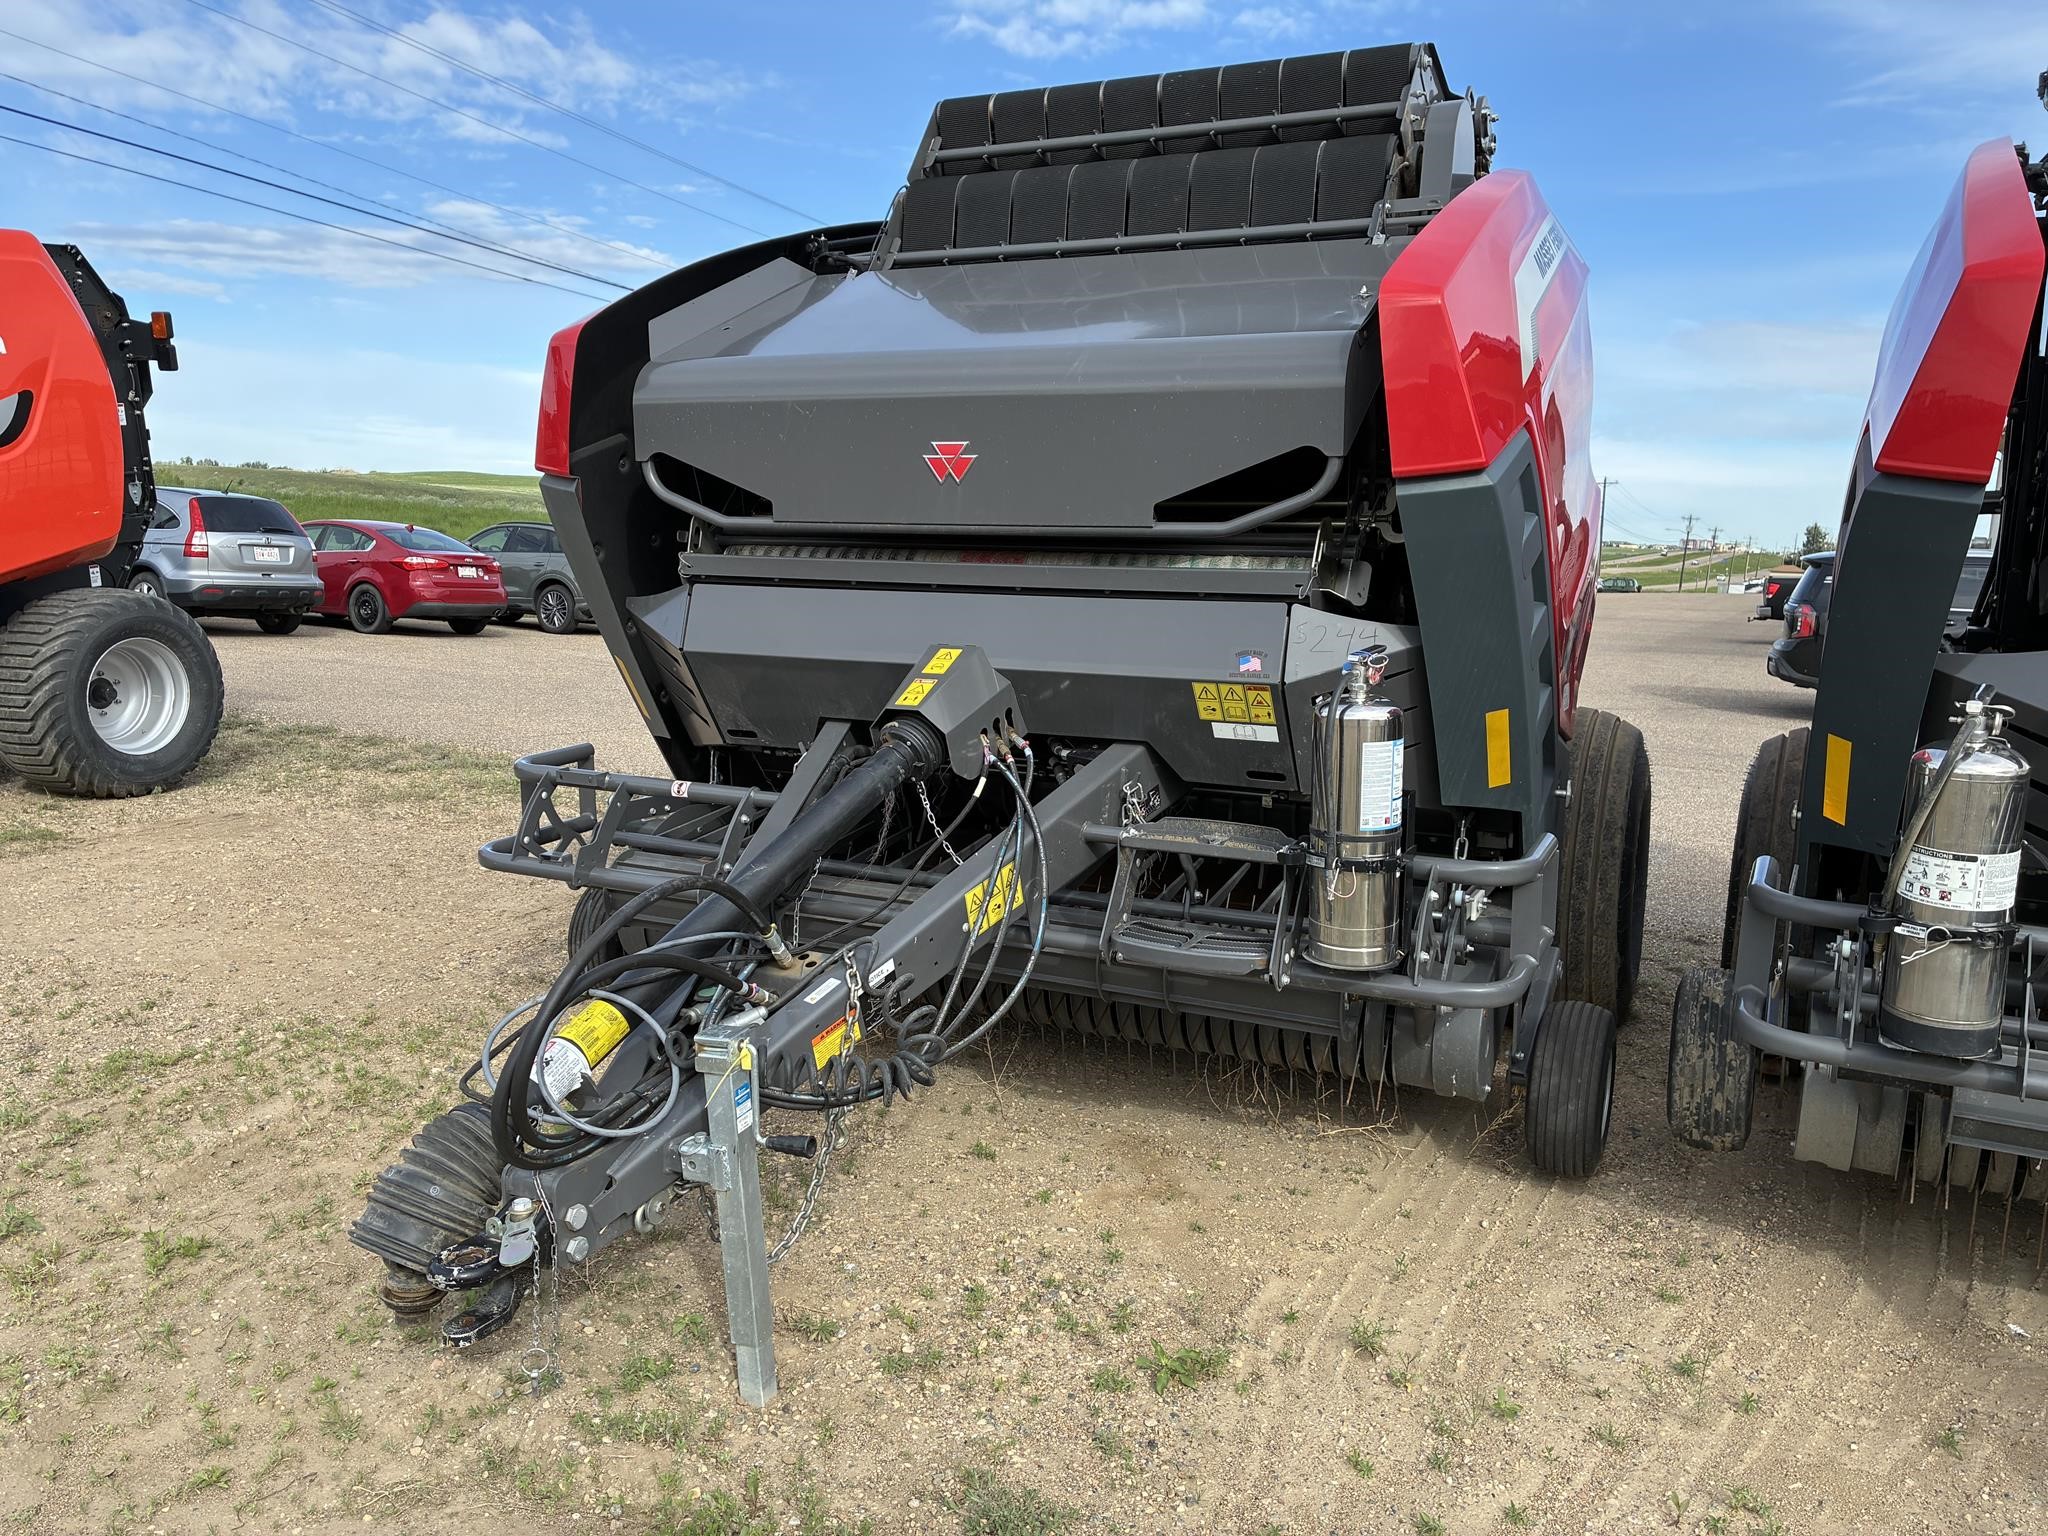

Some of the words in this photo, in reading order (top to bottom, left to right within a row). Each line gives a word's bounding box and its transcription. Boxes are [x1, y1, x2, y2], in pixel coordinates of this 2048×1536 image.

[1913, 846, 1953, 859] STRUCTIONS
[870, 968, 885, 983] OTICE
[825, 1017, 846, 1036] WARNIN
